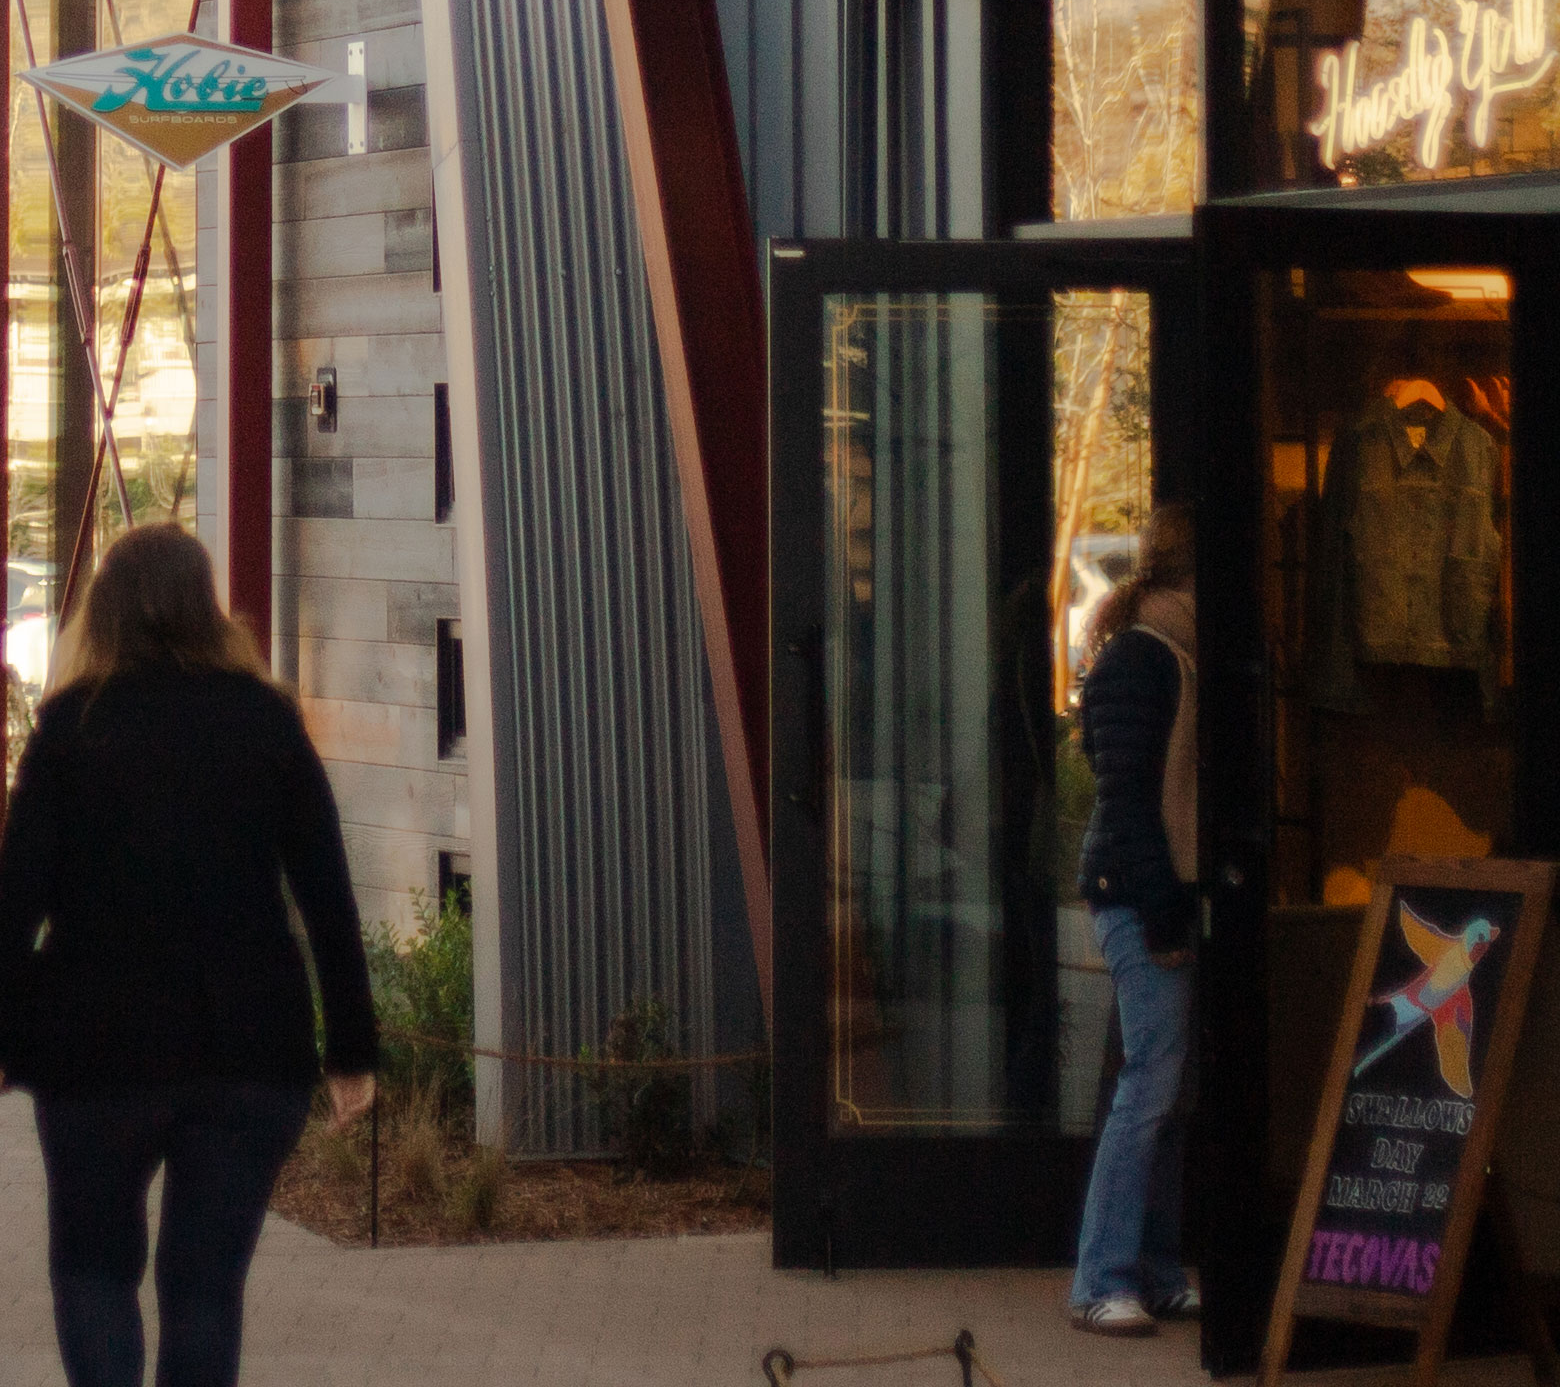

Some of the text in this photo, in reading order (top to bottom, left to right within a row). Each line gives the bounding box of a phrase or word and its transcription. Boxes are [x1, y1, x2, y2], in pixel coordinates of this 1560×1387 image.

[91, 47, 268, 113] Hobie
[128, 115, 238, 125] SURFBOARDS
[1345, 1093, 1476, 1135] SWALLOWS
[1370, 1137, 1425, 1174] DAY
[1327, 1176, 1419, 1213] MARCH
[1308, 1230, 1442, 1294] TECOVAS
